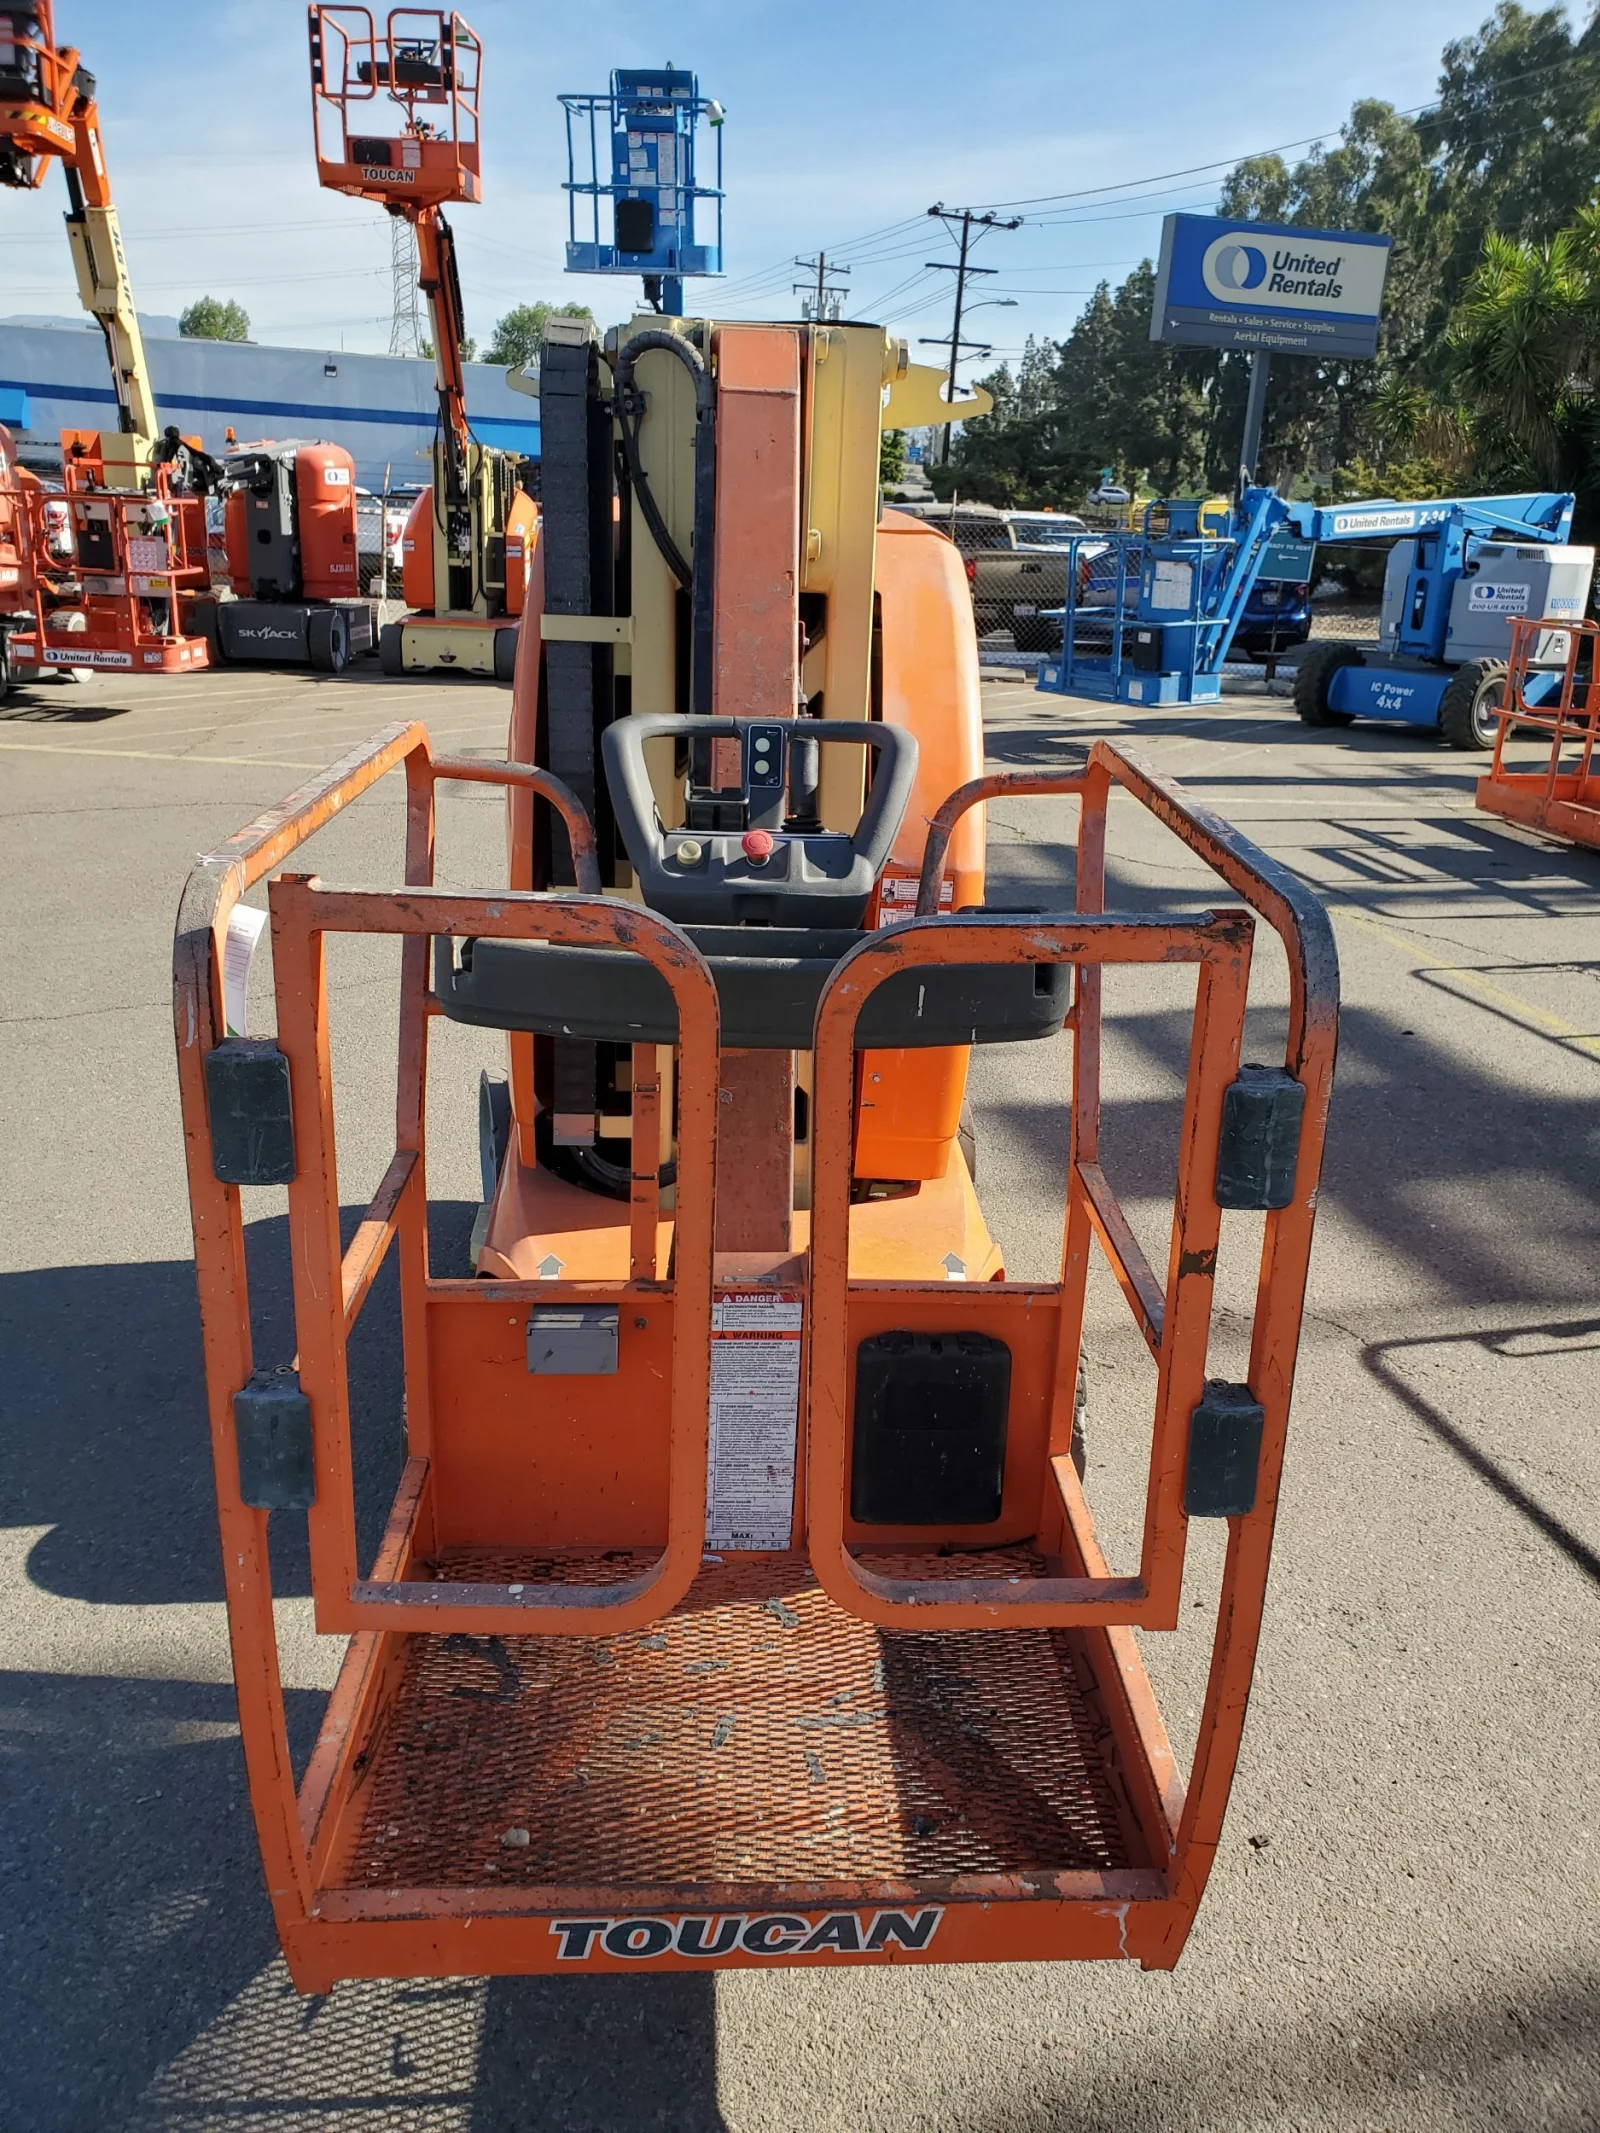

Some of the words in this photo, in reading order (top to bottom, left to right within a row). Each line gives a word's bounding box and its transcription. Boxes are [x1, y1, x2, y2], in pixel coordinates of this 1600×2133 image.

[362, 167, 415, 183] TOUCAN
[1272, 250, 1342, 275] United
[111, 225, 124, 265] JLG
[120, 272, 135, 319] LIFT
[1268, 273, 1343, 298] Rentals
[1209, 312, 1238, 324] Rentals
[1244, 316, 1264, 327] Sales
[1269, 318, 1297, 330] Service
[1303, 321, 1336, 334] Supplies
[1233, 331, 1260, 342] Aerial
[1261, 333, 1307, 347] Equipment
[1349, 516, 1378, 529] United
[1379, 514, 1411, 527] Rentals
[1495, 593, 1526, 601] Rentals
[1497, 586, 1524, 594] United
[238, 625, 298, 640] SKYJACK
[60, 652, 91, 662] United
[93, 654, 128, 665] Rentals
[1370, 681, 1382, 692] IC
[1383, 683, 1415, 696] Power
[1376, 694, 1402, 710] 4x4
[735, 1294, 780, 1303] DANGER
[733, 1332, 783, 1340] WARNING
[548, 1904, 947, 1961] TOUCAN
